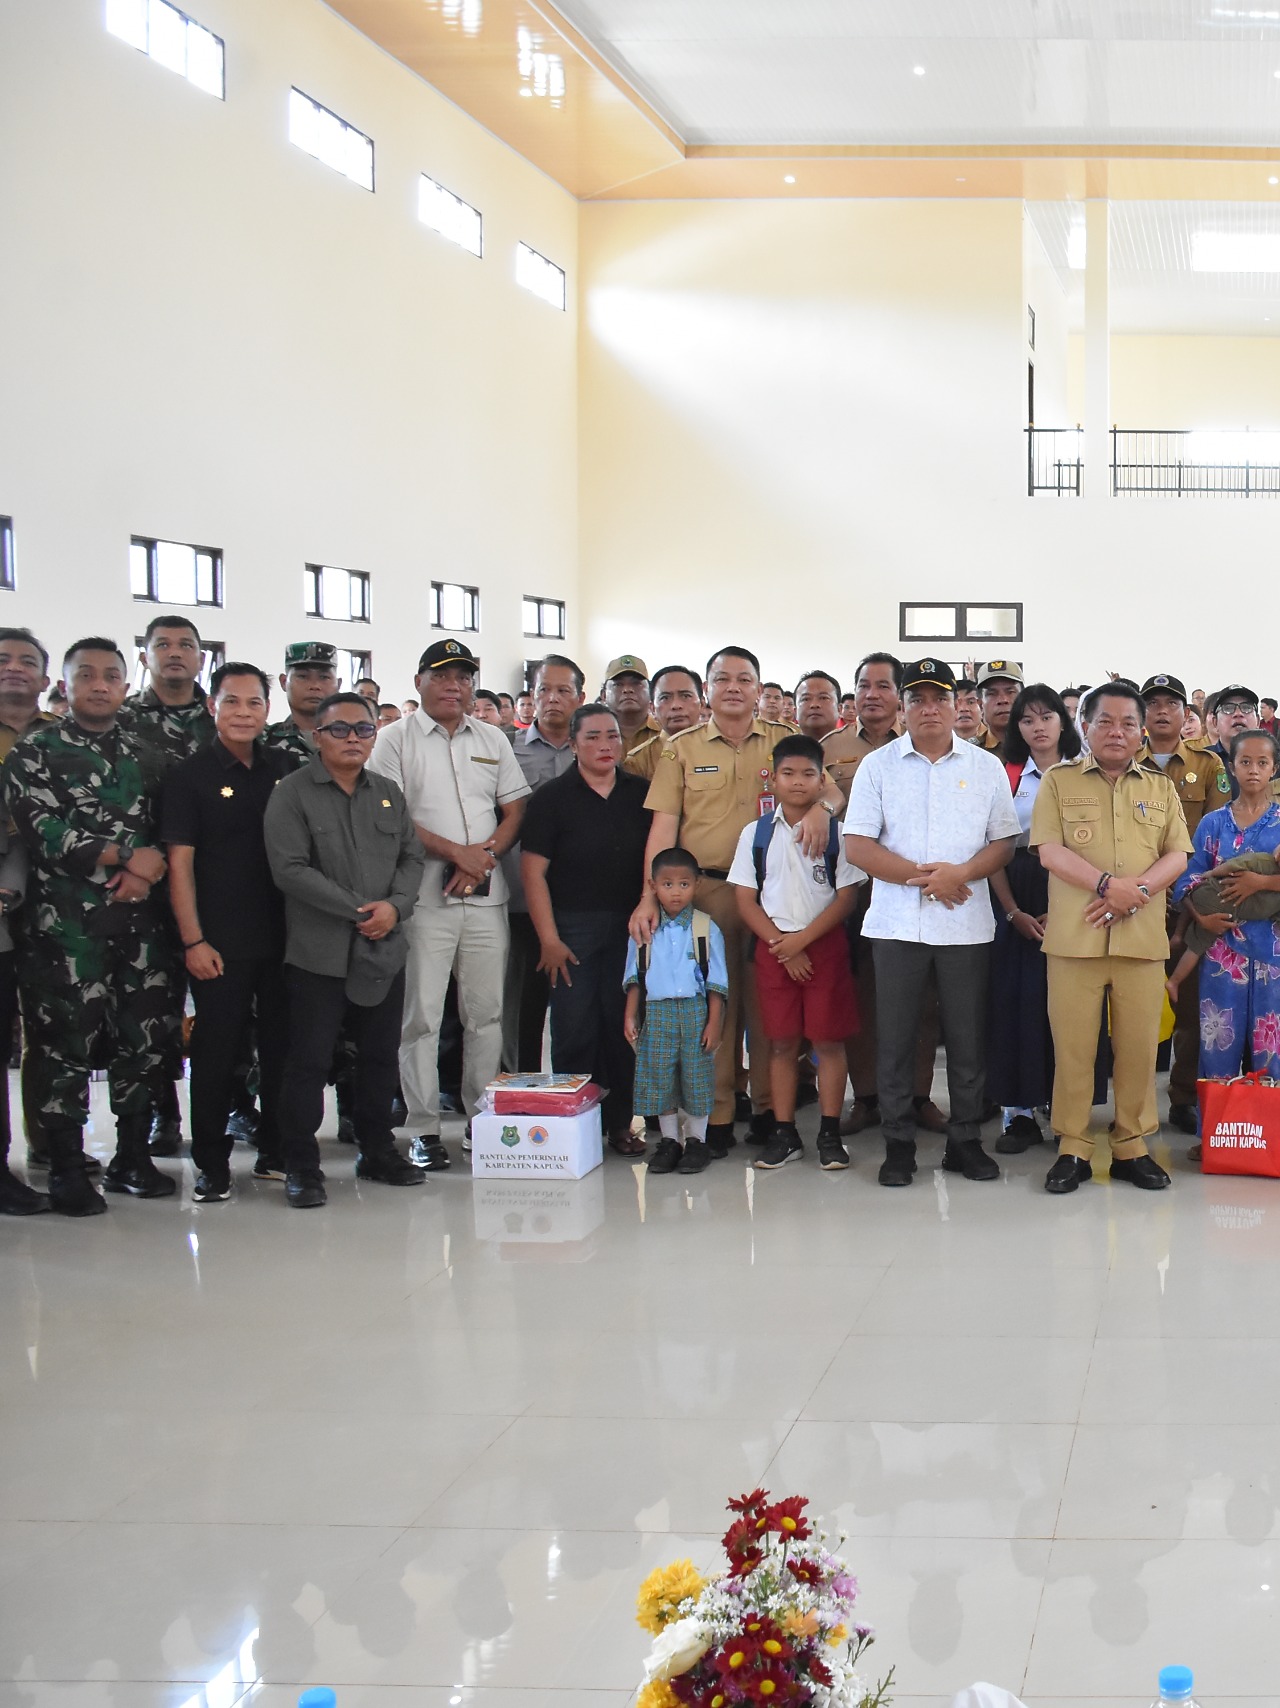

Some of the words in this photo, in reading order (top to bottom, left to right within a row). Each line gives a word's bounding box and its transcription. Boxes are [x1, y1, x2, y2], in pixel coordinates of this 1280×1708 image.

[1215, 1122, 1263, 1138] BANTUAN
[1210, 1135, 1238, 1148] BUPATI
[1239, 1136, 1267, 1149] KAPUAS
[518, 1154, 569, 1162] PEMERINTAH
